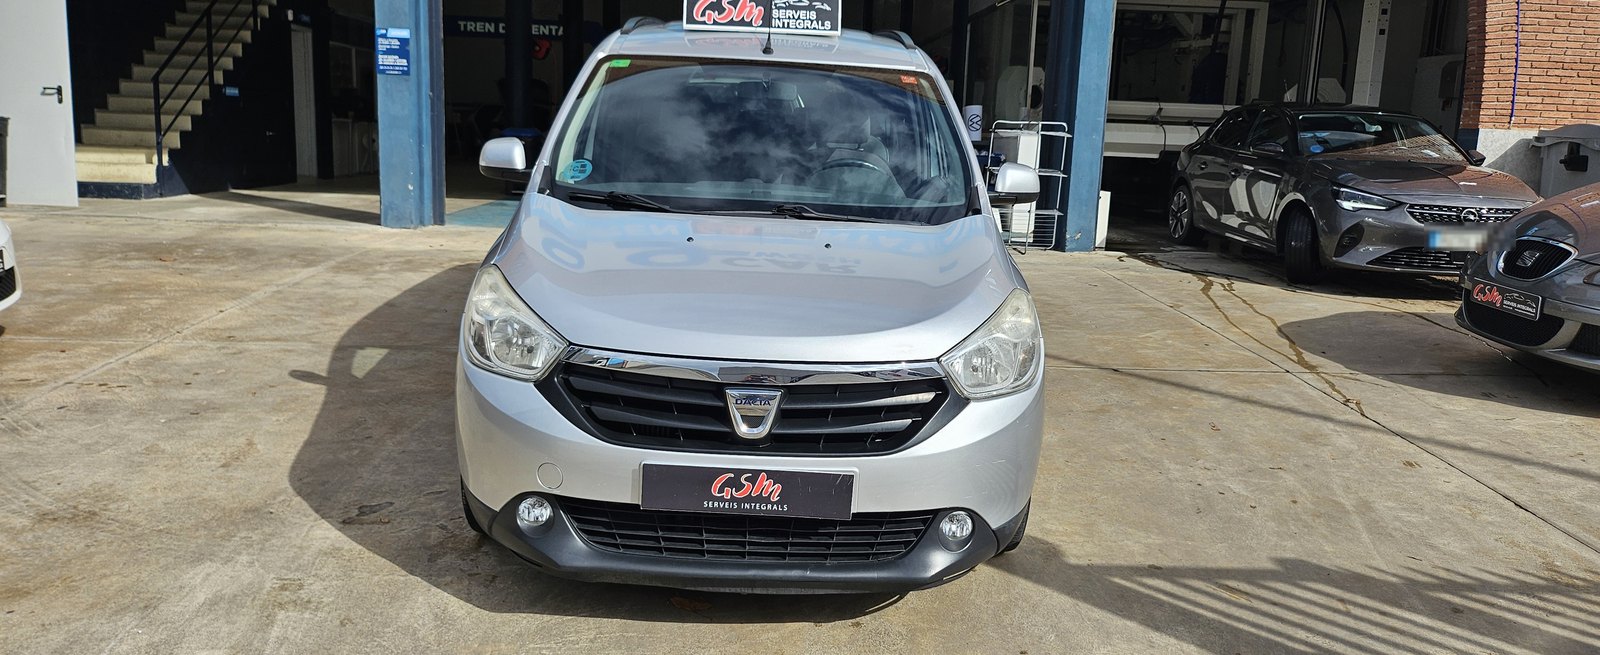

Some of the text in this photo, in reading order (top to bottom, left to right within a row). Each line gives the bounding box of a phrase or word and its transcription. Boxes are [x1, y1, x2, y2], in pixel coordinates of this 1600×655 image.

[772, 9, 817, 20] SERVEIS
[458, 21, 495, 33] TREN
[772, 19, 832, 30] INTEGRALS
[735, 398, 771, 406] DACIA
[703, 501, 788, 511] SERVEIS INTEGRALS
